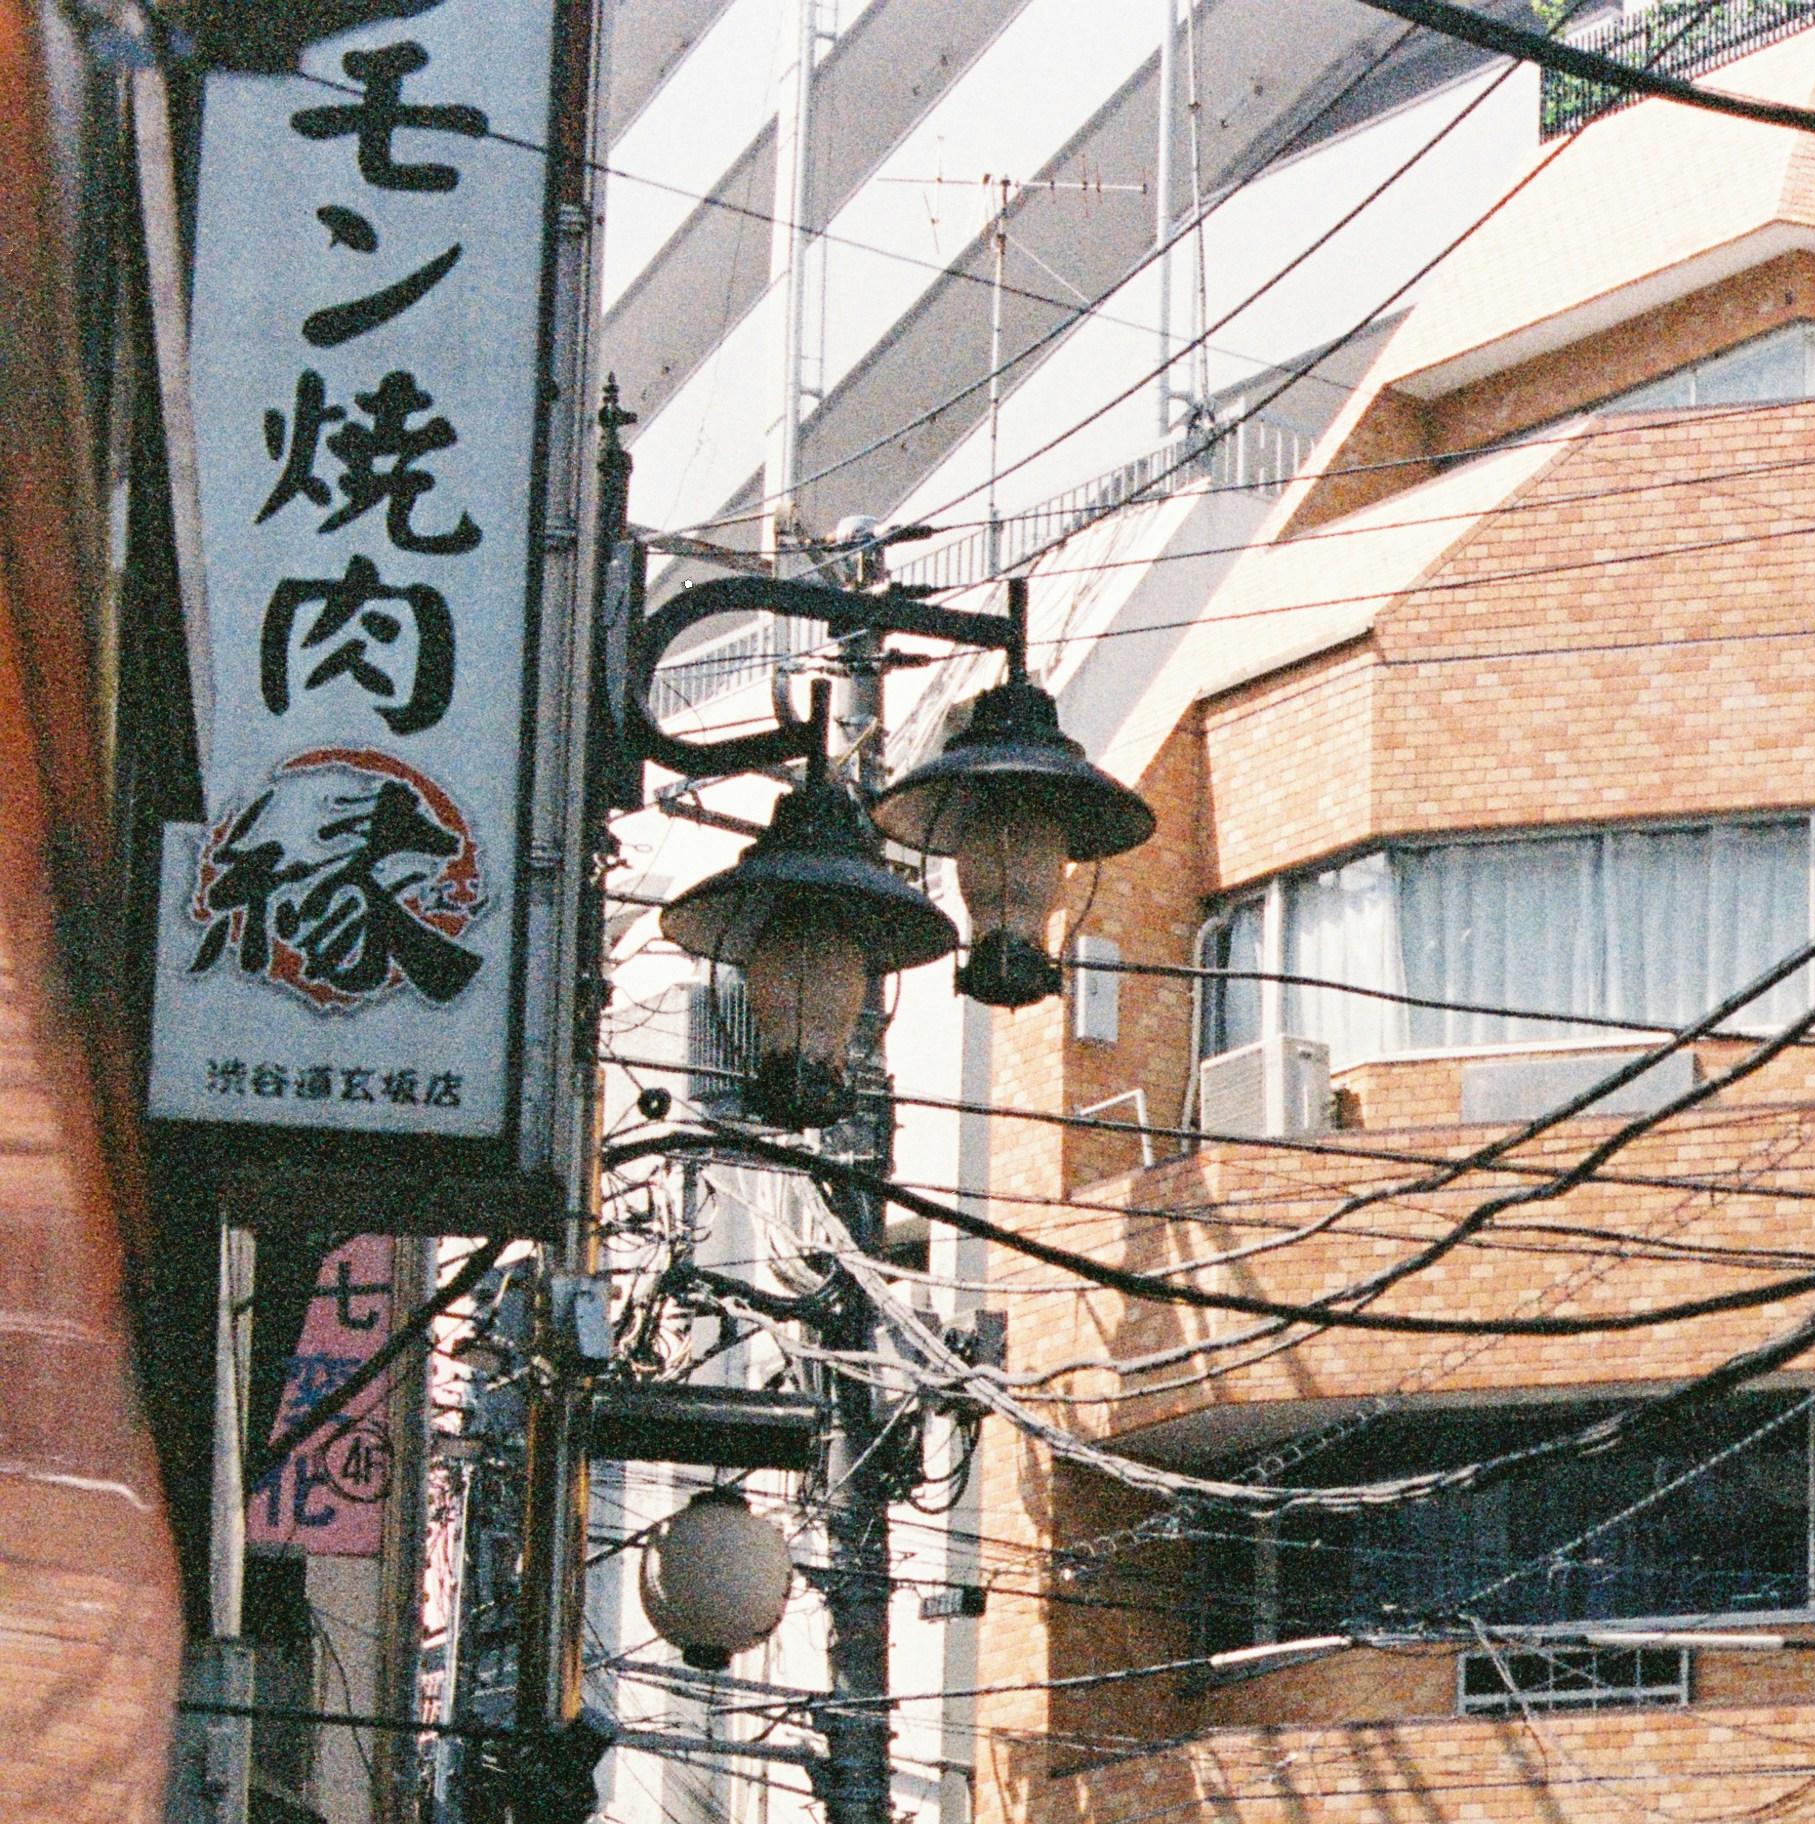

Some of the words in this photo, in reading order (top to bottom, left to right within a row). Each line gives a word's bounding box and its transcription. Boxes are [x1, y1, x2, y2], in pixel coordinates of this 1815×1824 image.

[204, 1057, 463, 1108] 渋谷道玄坂店
